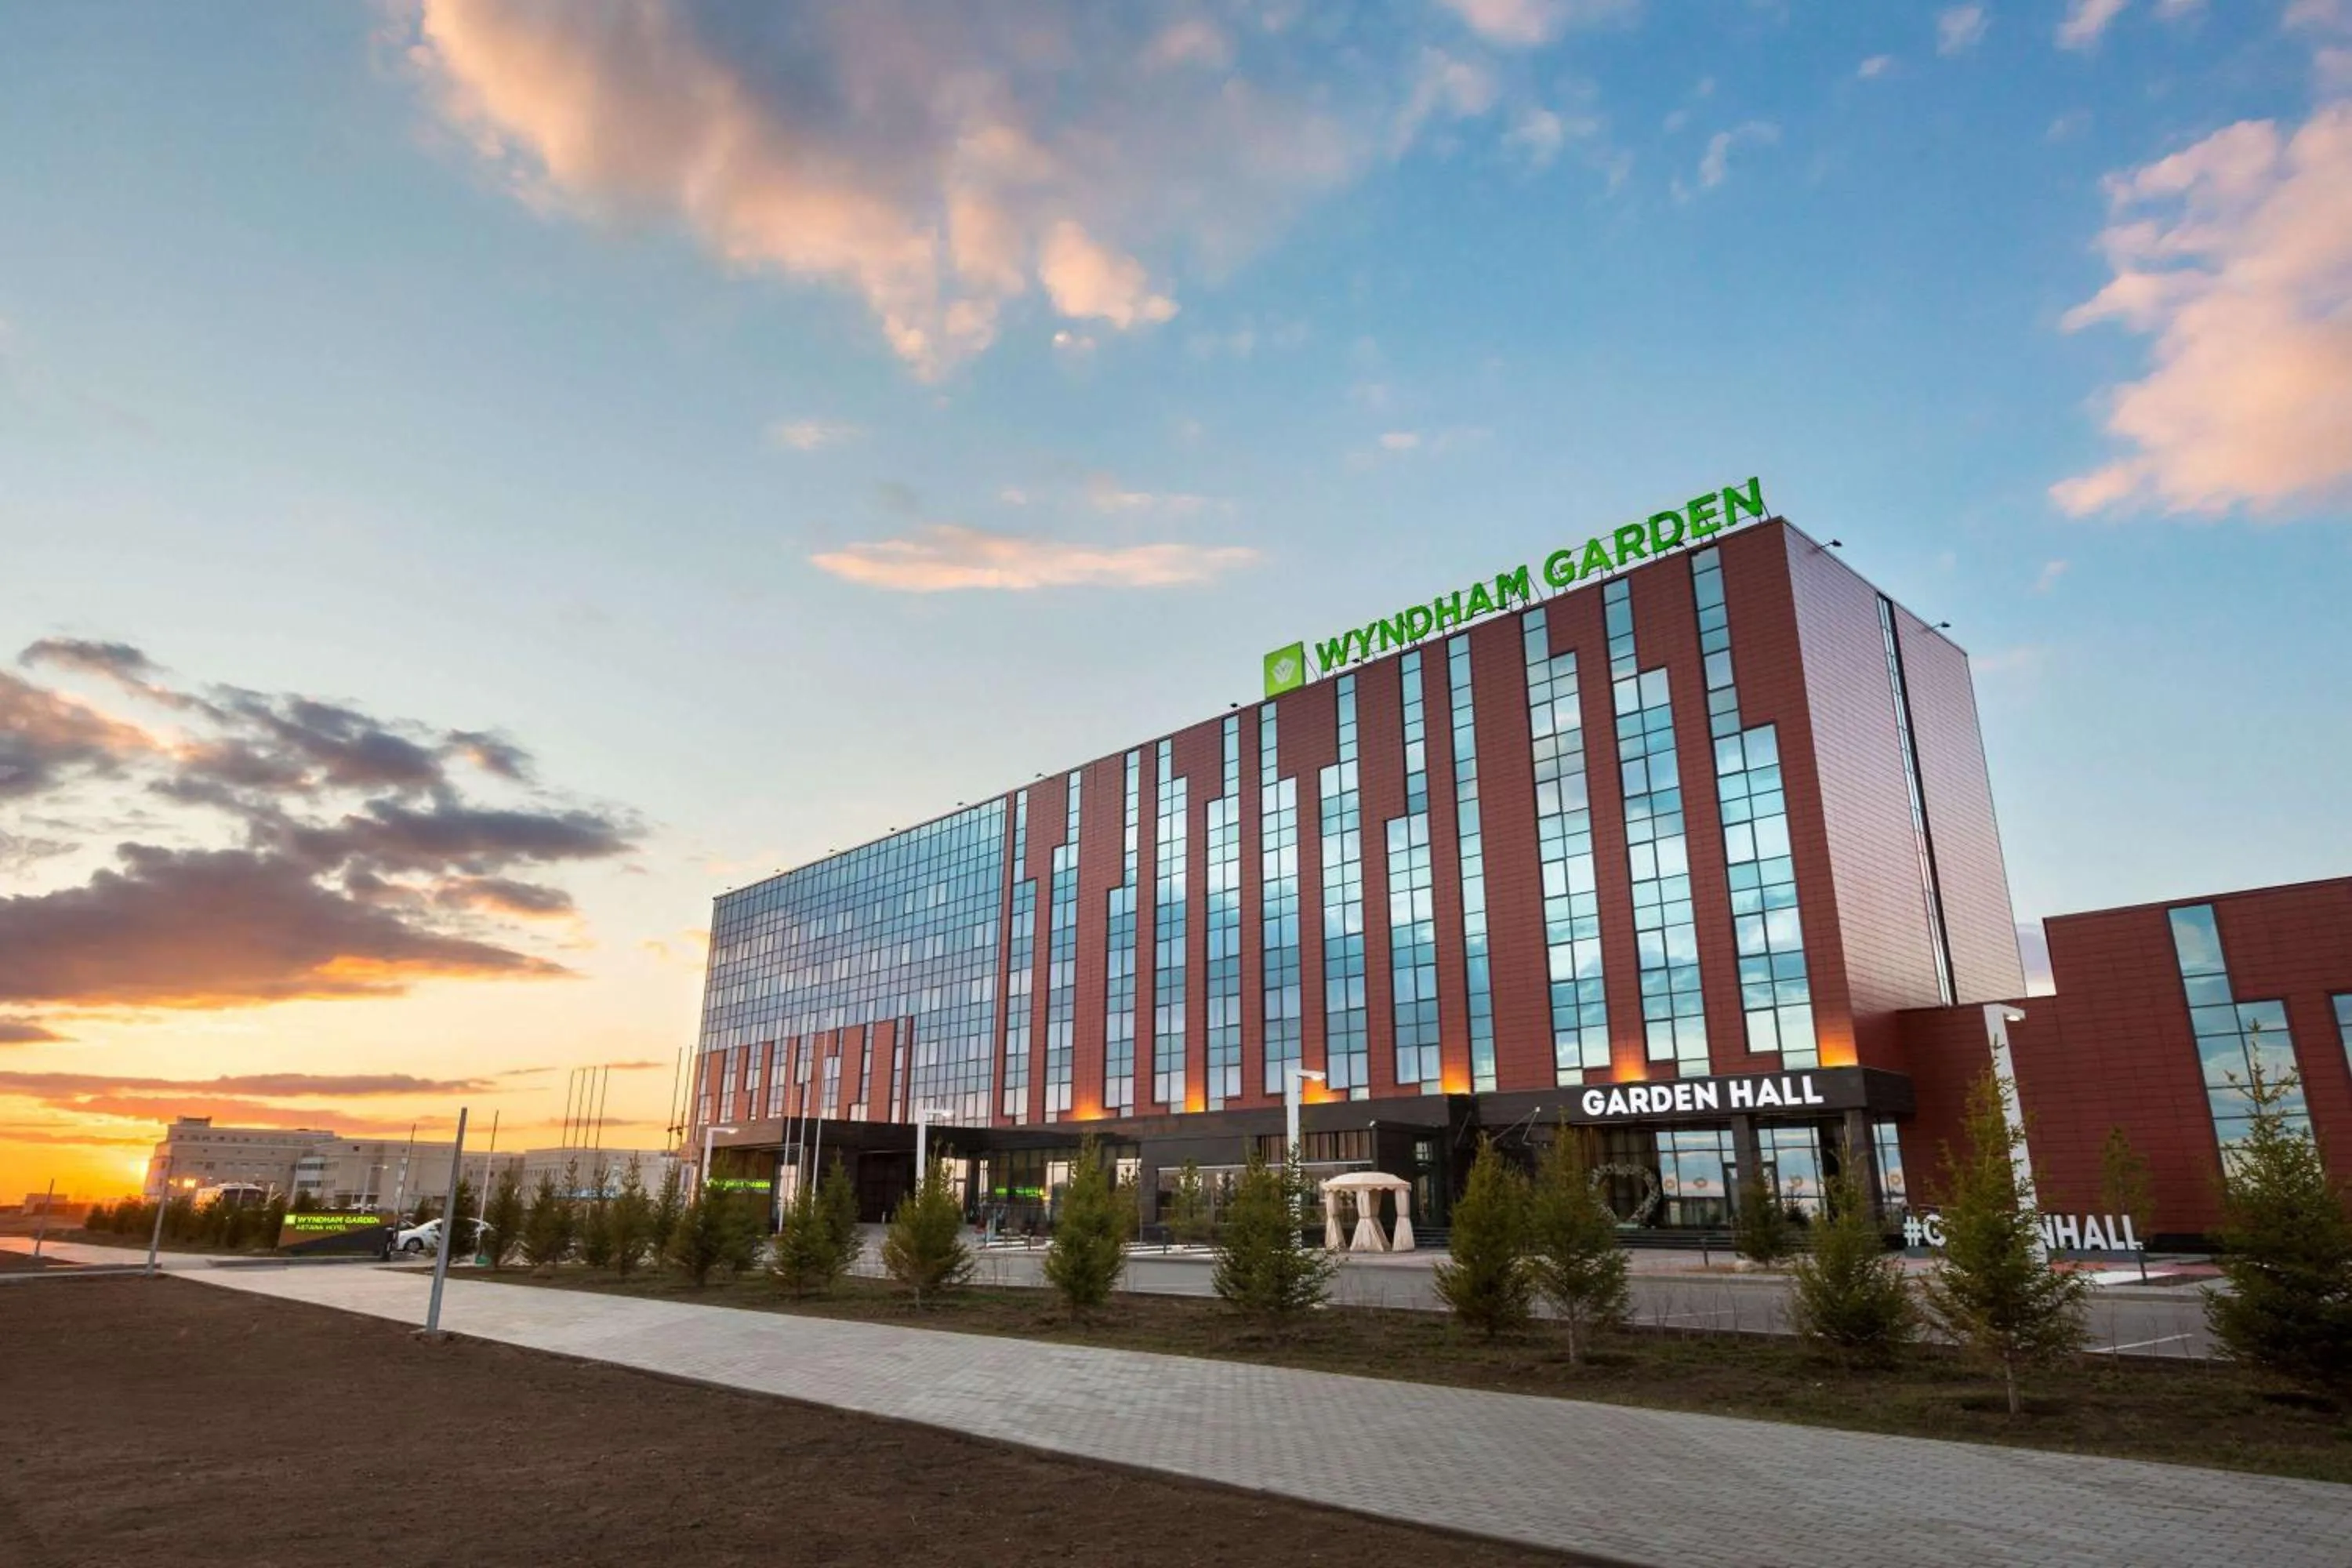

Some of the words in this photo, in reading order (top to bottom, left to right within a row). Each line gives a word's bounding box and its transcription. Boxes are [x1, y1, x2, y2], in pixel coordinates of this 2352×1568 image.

[1315, 564, 1530, 672] WYNDHAM
[1542, 477, 1763, 588] GARDEN
[1581, 1081, 1719, 1116] GARDEN
[1730, 1075, 1824, 1108] HALL
[297, 1215, 343, 1224] WYNDHAM
[1903, 1214, 2143, 1250] #GNHALL
